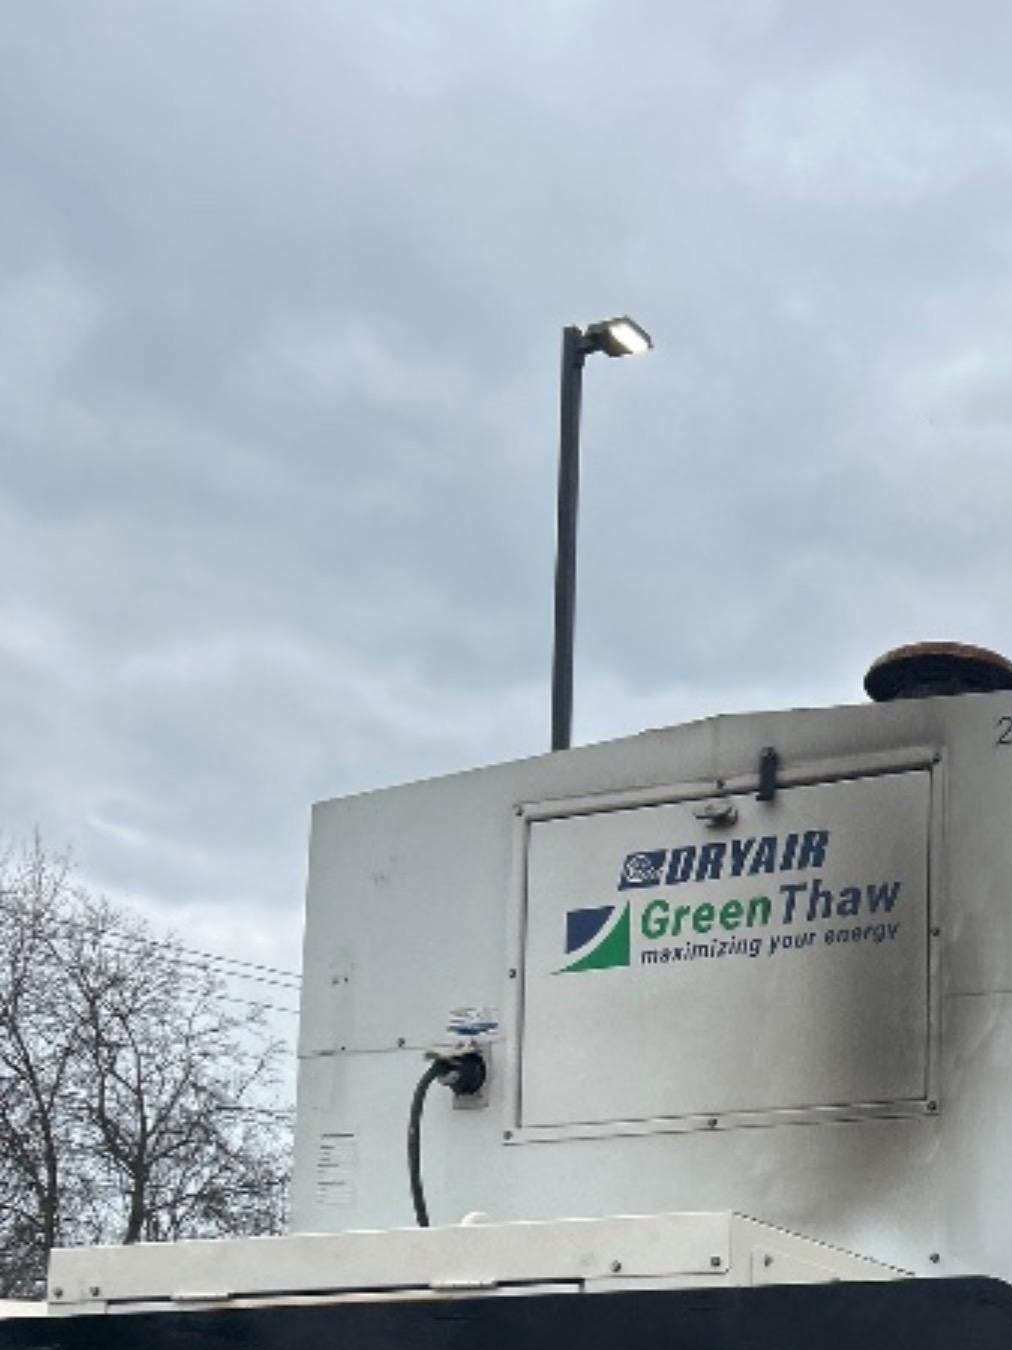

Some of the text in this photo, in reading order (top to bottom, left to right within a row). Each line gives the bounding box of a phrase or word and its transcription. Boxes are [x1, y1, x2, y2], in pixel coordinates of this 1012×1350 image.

[665, 829, 830, 886] DRYAIR
[640, 923, 900, 966] maximizing your energy
